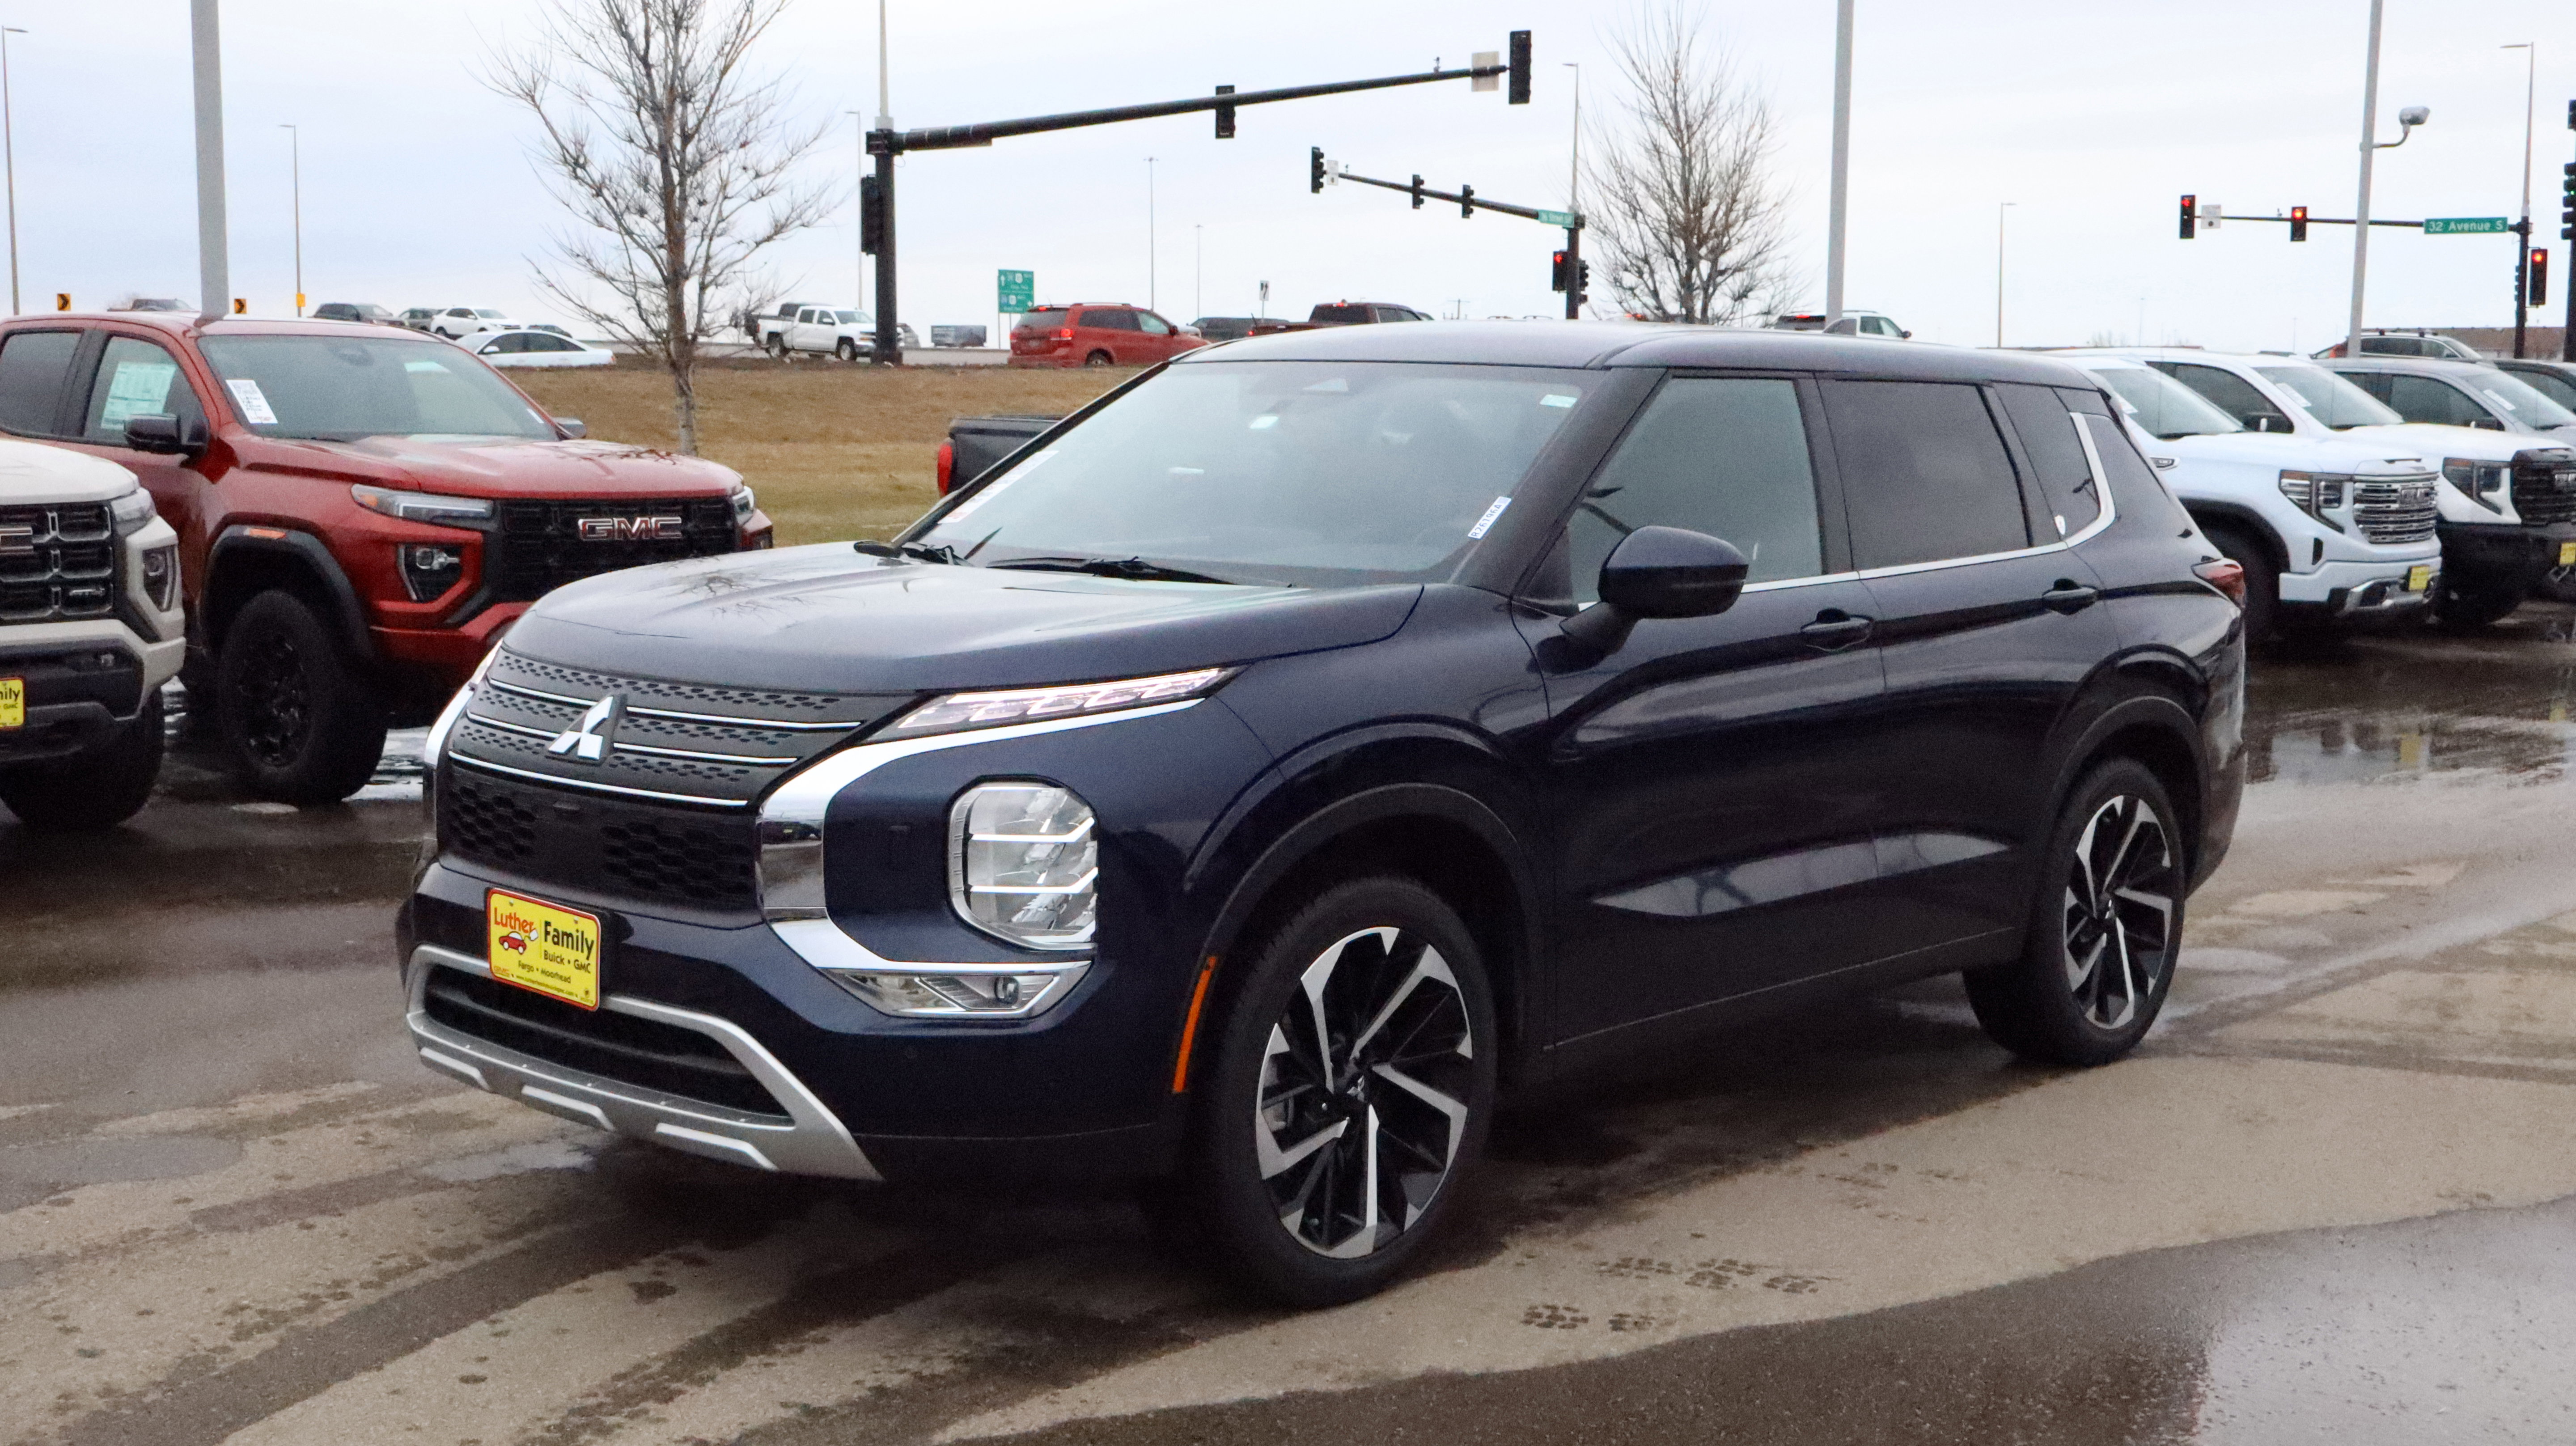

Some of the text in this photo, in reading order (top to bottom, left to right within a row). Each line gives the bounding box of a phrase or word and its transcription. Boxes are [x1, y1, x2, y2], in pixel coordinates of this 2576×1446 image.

[2429, 221, 2503, 231] 32 Avenue S
[578, 516, 682, 541] GMC
[1471, 505, 1502, 537] R26196A
[494, 907, 535, 933] Luther
[544, 920, 594, 961] Family
[518, 960, 571, 984] Fargo Moorhead
[544, 949, 591, 974] Buick GMC
